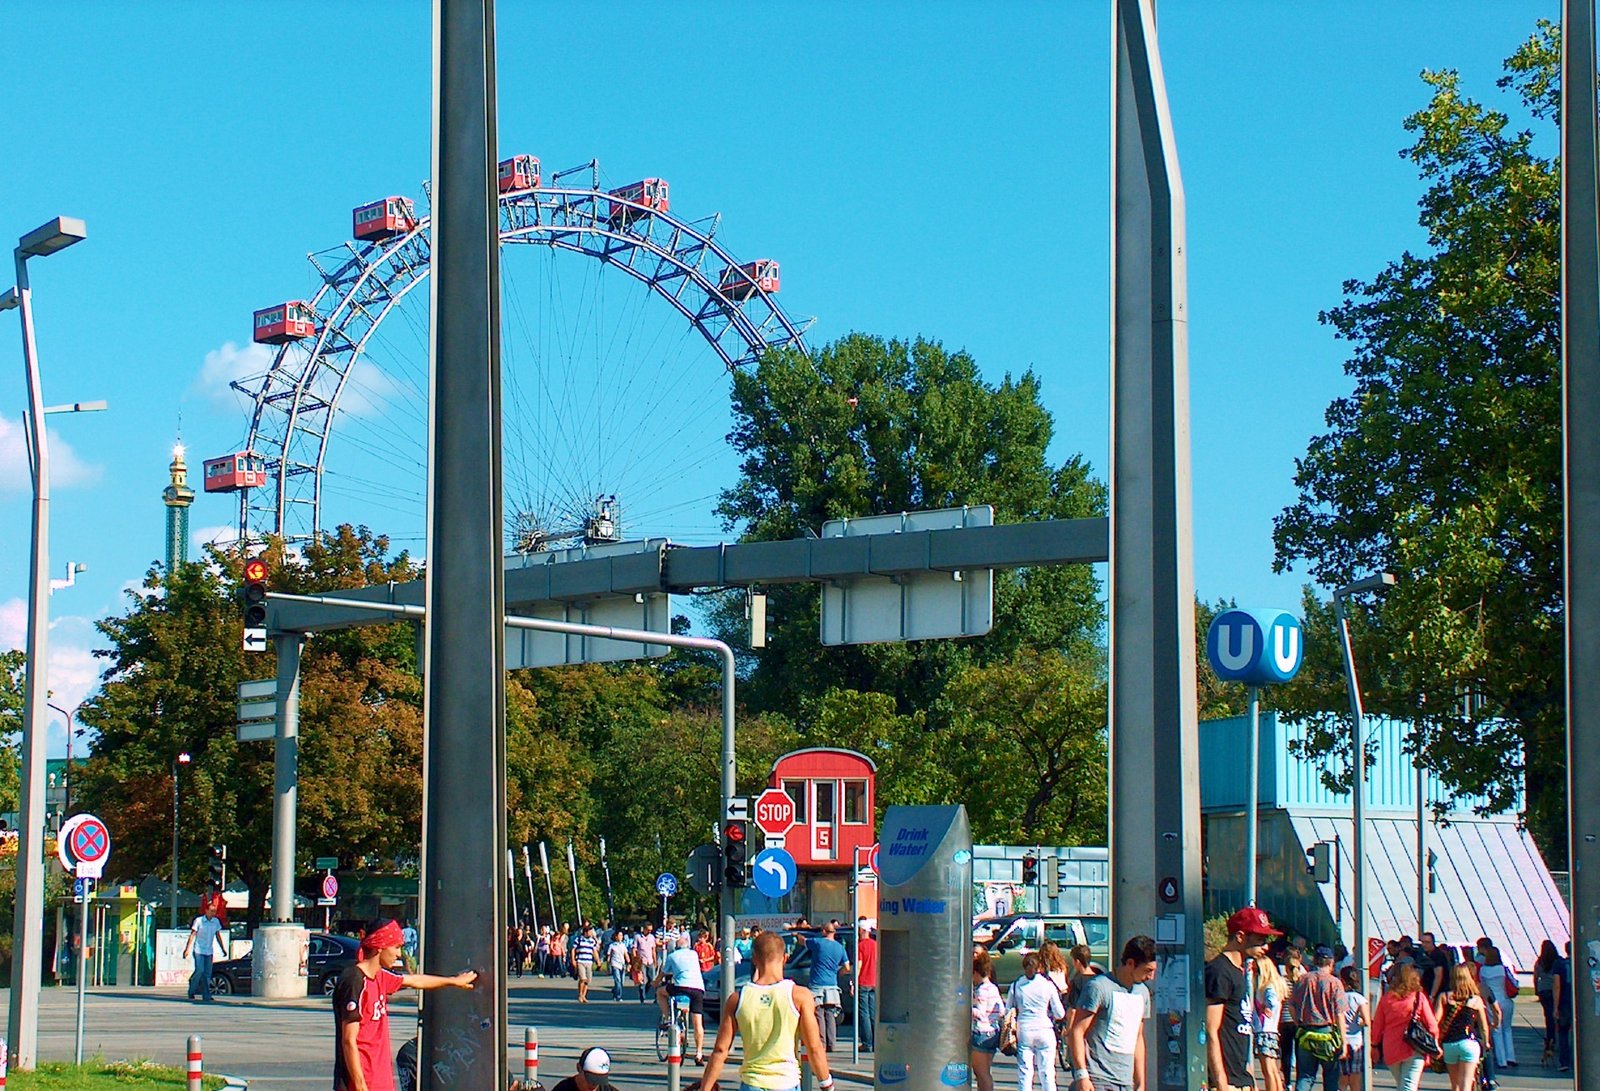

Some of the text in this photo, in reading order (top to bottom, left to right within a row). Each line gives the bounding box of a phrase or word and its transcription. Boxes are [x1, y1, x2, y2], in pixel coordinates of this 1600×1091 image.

[1217, 624, 1254, 671] U
[1274, 625, 1298, 673] U
[759, 803, 791, 822] STOP
[896, 828, 929, 841] Drink
[888, 843, 928, 856] Water!
[902, 897, 946, 914] Water
